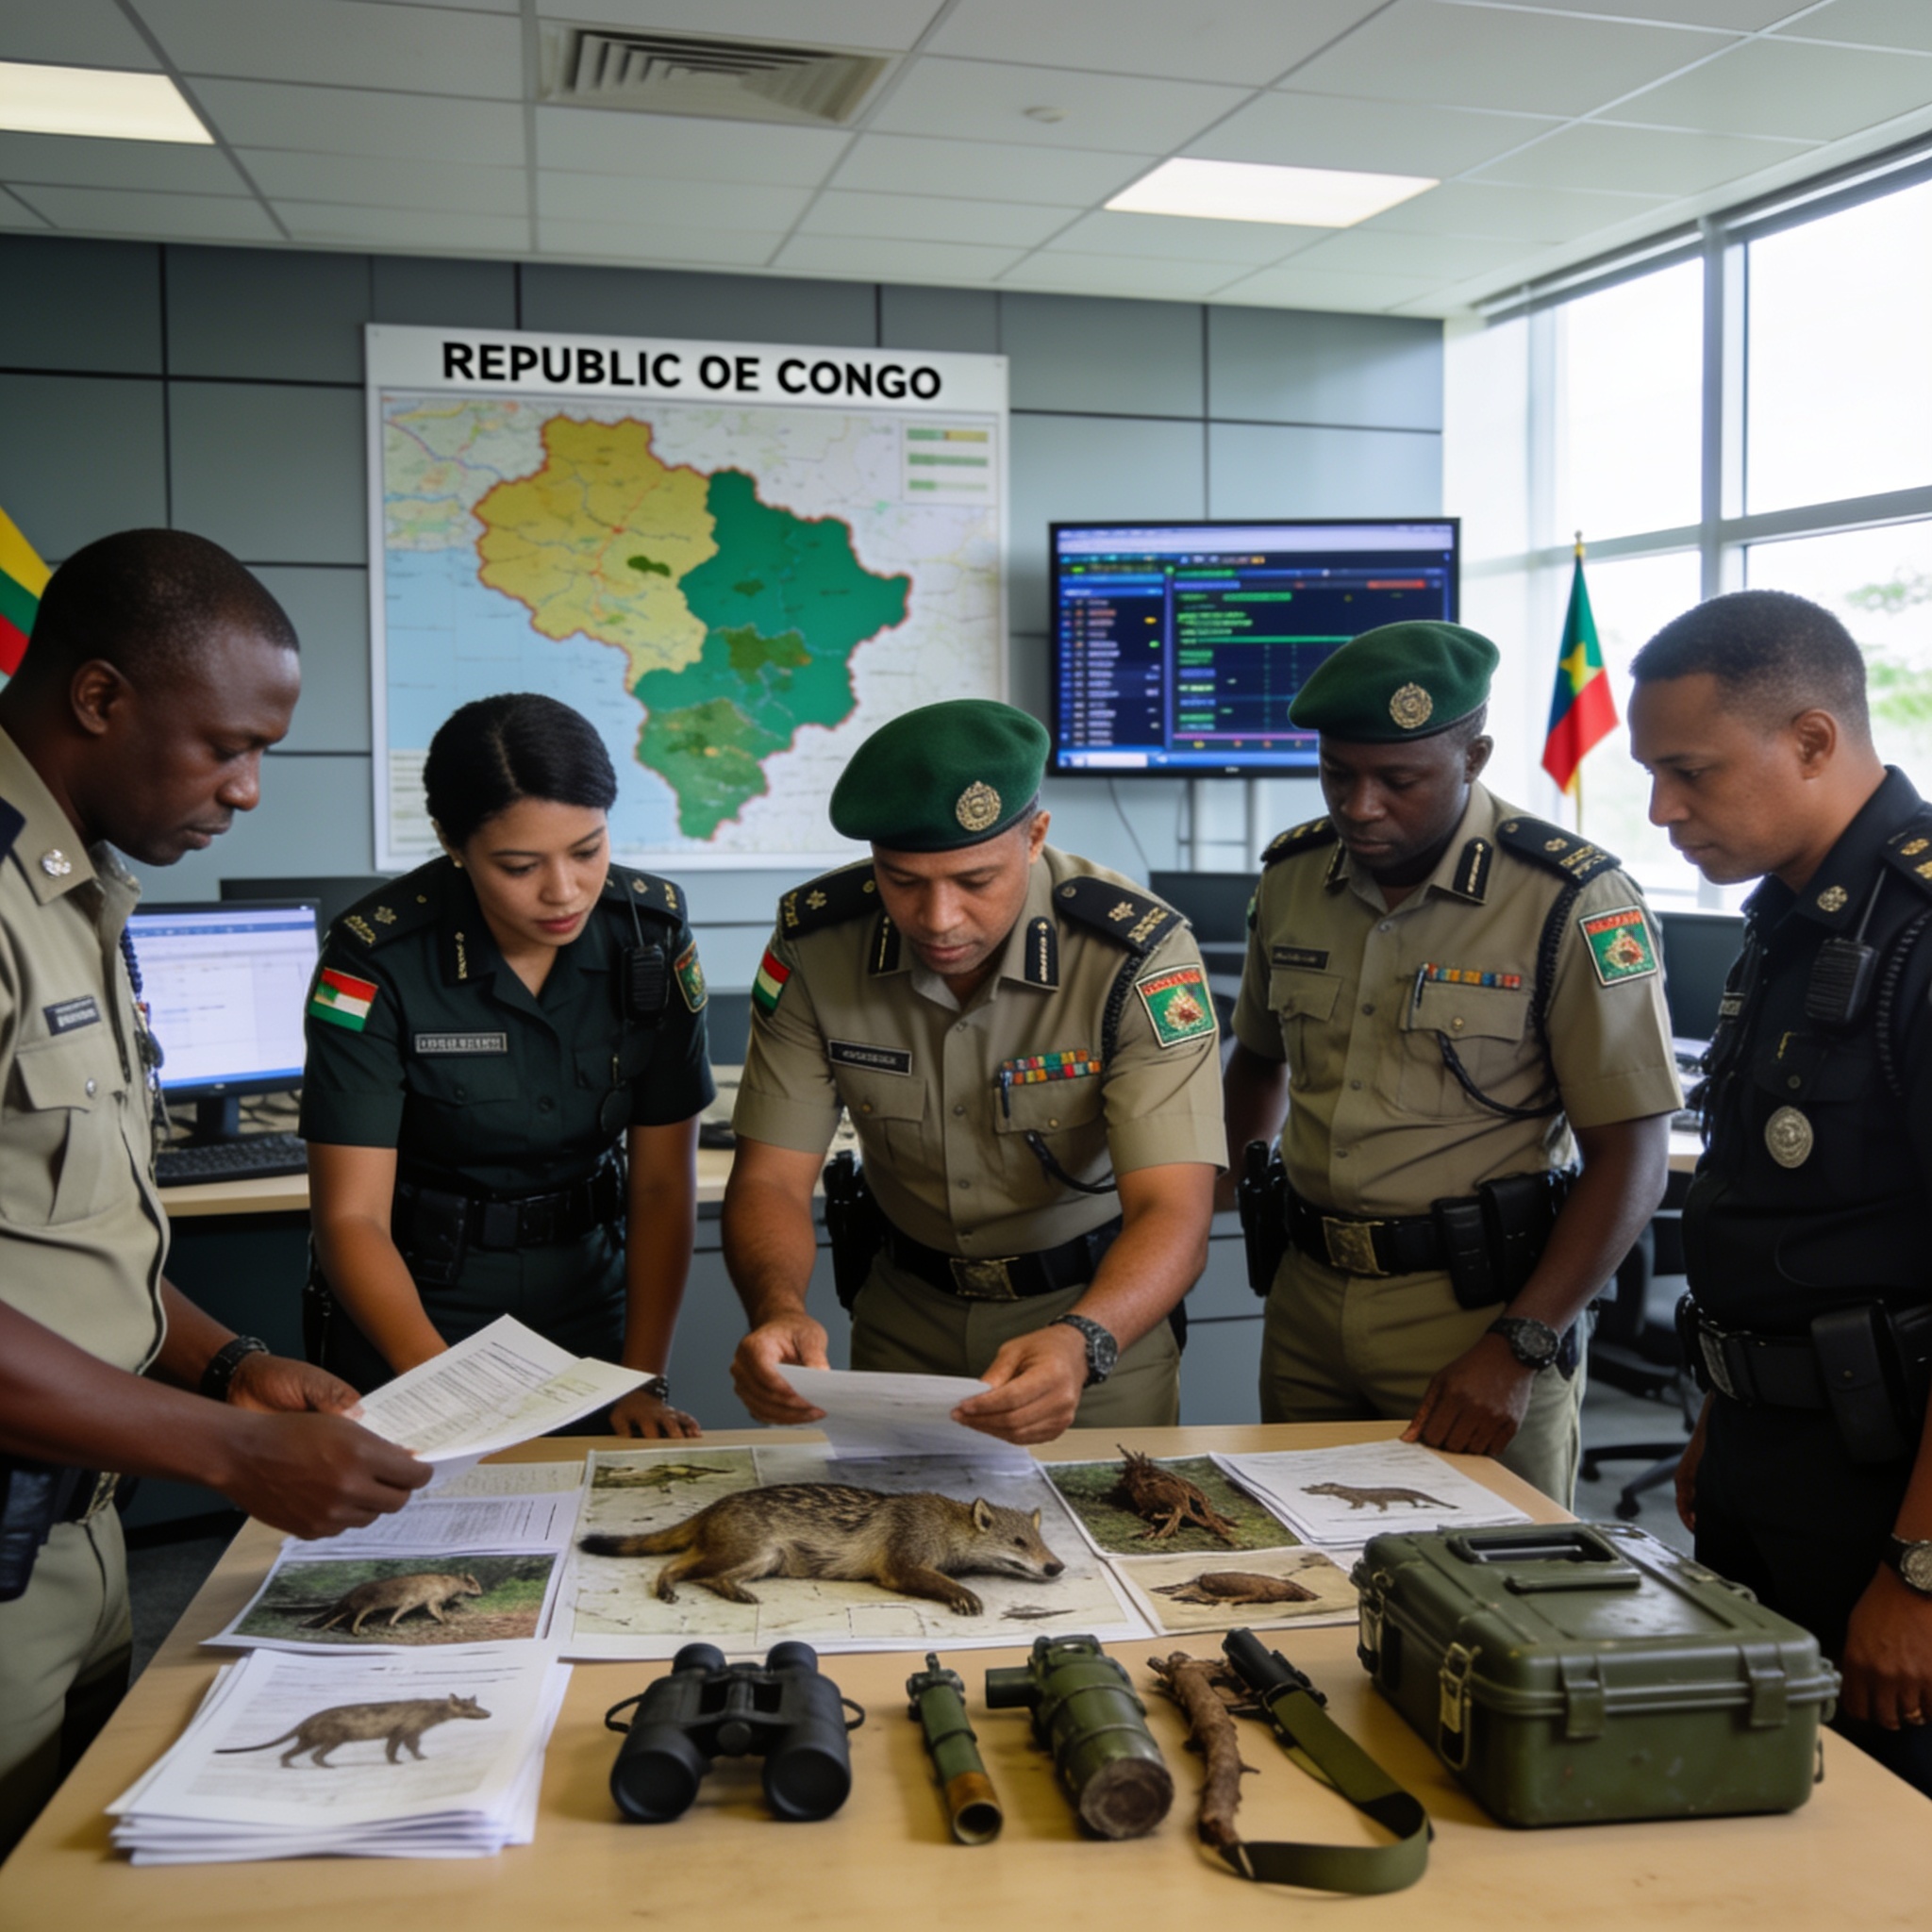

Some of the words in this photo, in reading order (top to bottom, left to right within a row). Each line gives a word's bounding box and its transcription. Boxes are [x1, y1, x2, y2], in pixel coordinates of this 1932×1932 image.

[442, 341, 682, 388] REPUBLIC
[699, 355, 760, 391] OE
[776, 358, 941, 400] CONGO
